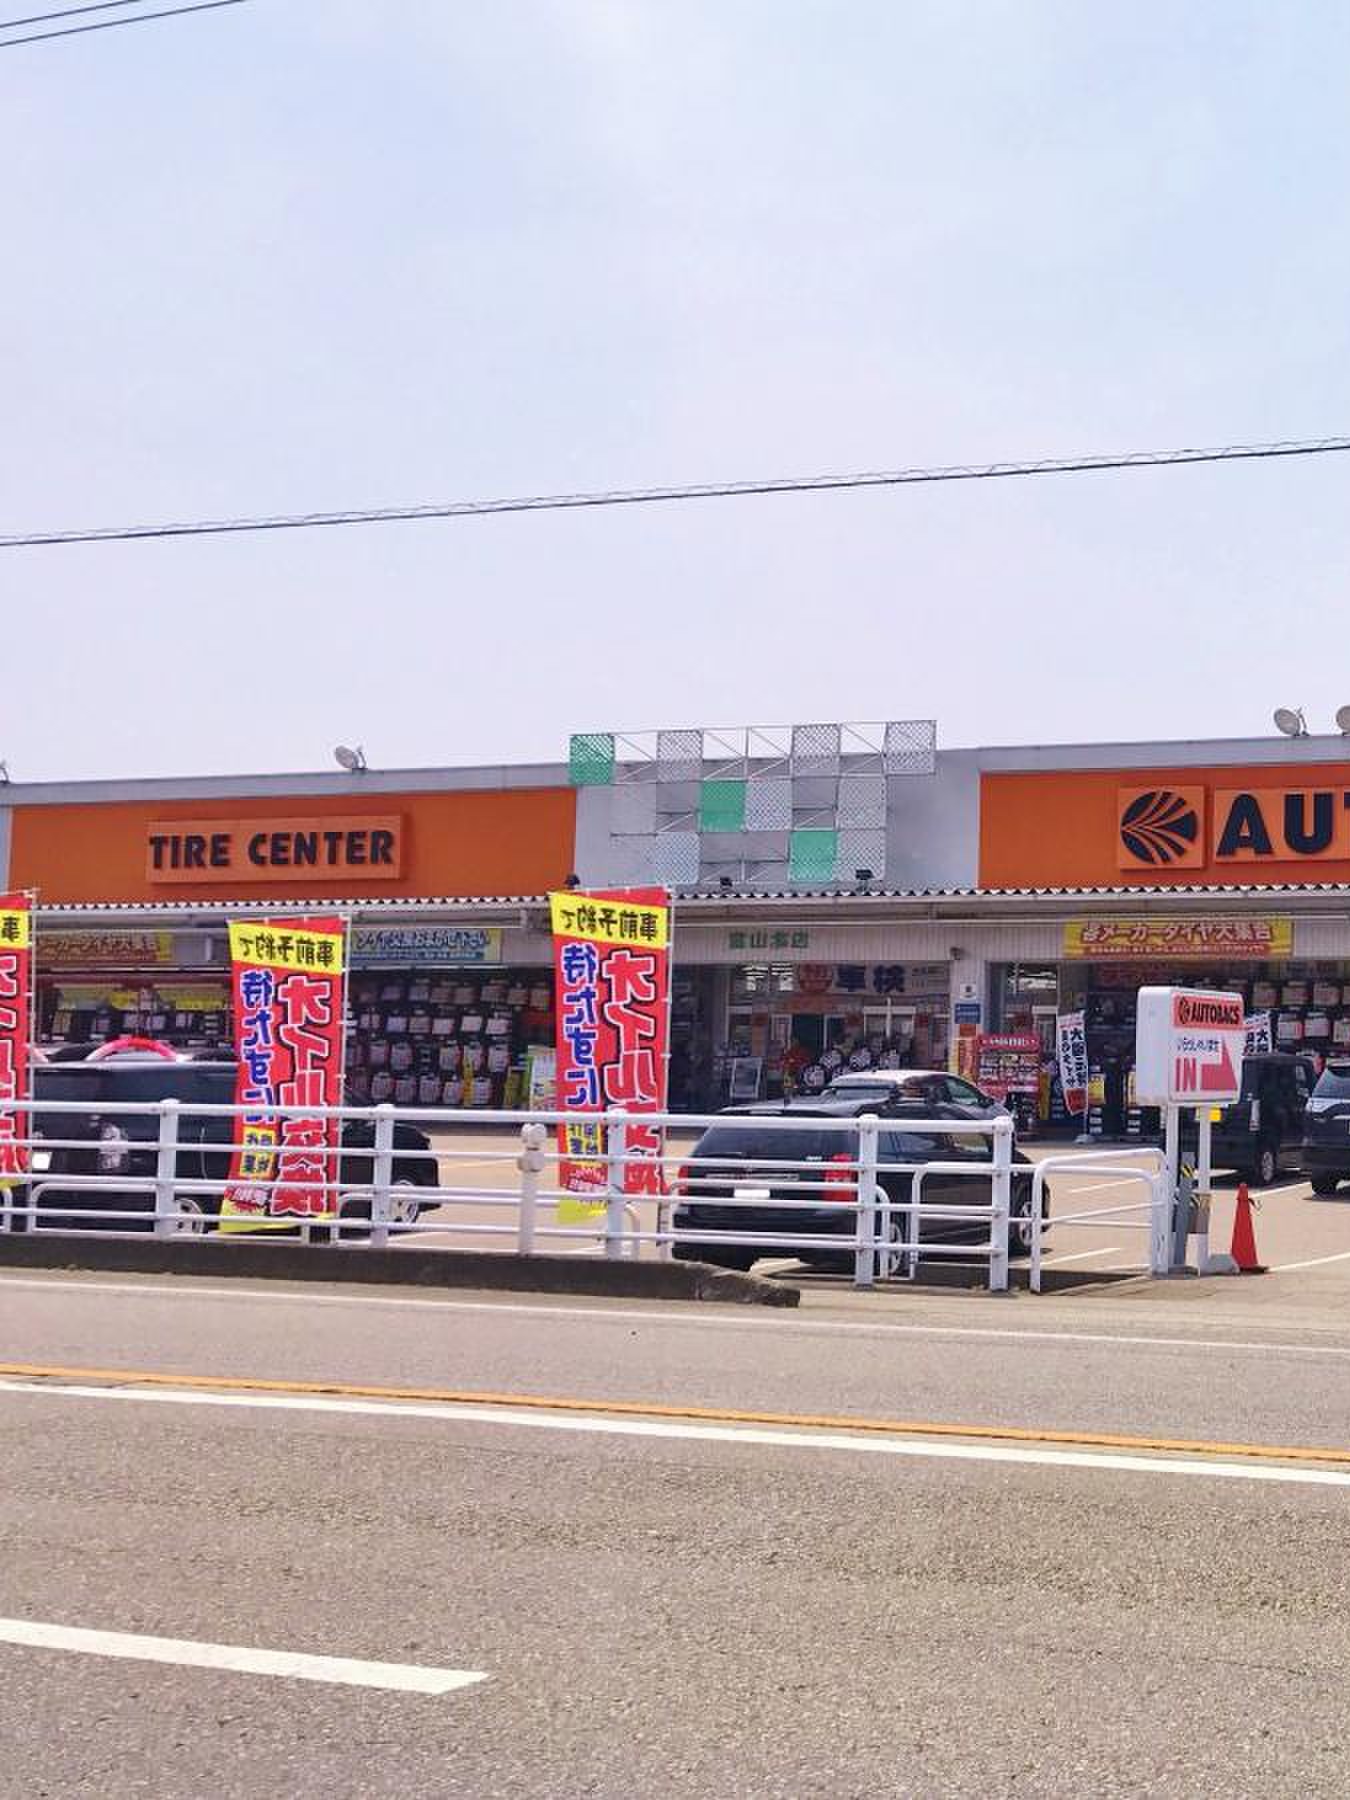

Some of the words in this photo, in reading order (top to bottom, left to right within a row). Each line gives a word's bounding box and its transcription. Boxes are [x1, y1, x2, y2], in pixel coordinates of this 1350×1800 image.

[149, 833, 231, 870] TIRE
[248, 830, 395, 867] CENTER
[1175, 1057, 1198, 1093] IN
